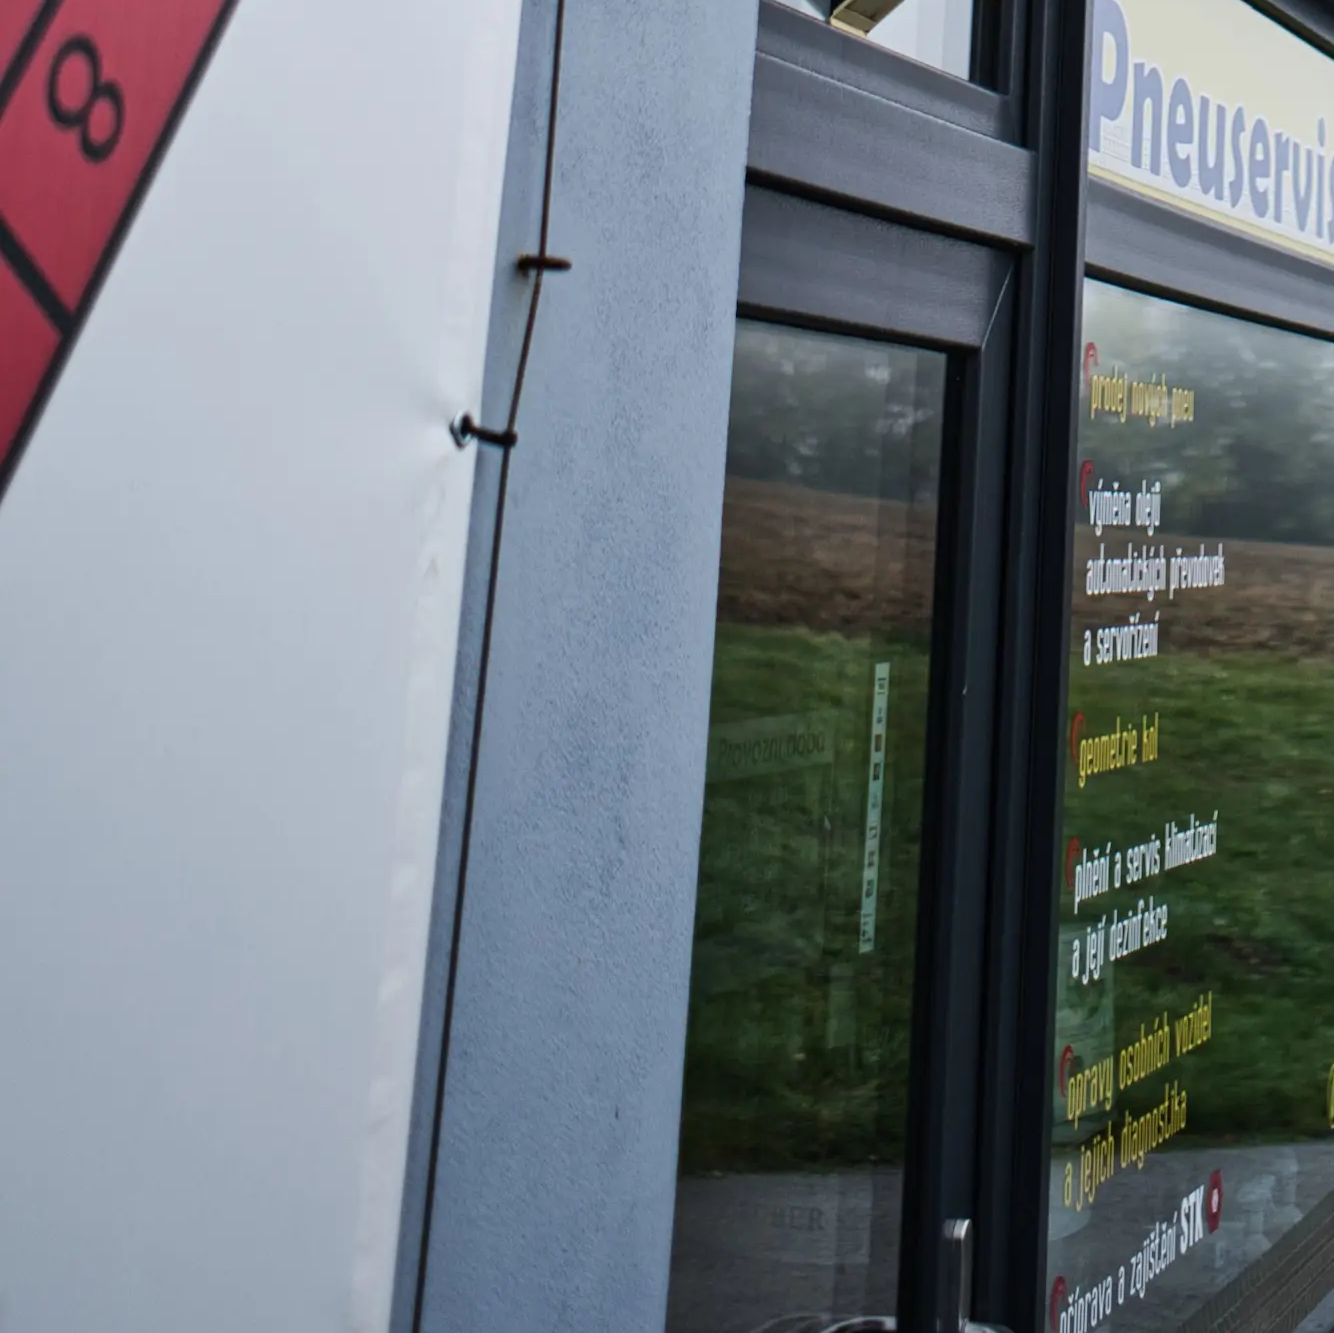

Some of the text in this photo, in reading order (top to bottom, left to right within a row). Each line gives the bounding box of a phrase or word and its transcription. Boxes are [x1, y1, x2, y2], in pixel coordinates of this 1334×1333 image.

[45, 32, 126, 164] 8
[1091, 364, 1127, 423] prodej
[1089, 478, 1161, 536] výměna olejů
[1085, 542, 1225, 602] automatických převodovek
[1083, 610, 1160, 666] a servořízení
[1078, 712, 1159, 789] geometrie kol
[1074, 809, 1219, 915] plnění a servis klimatizací
[1072, 937, 1080, 979] a
[1082, 914, 1107, 985] její
[1067, 990, 1212, 1130] opravy osobních vozidel
[1064, 1080, 1187, 1212] a jejich diagnostika
[1118, 1265, 1126, 1305] a
[1130, 1211, 1178, 1299] zajištění
[1180, 1185, 1204, 1254] STK
